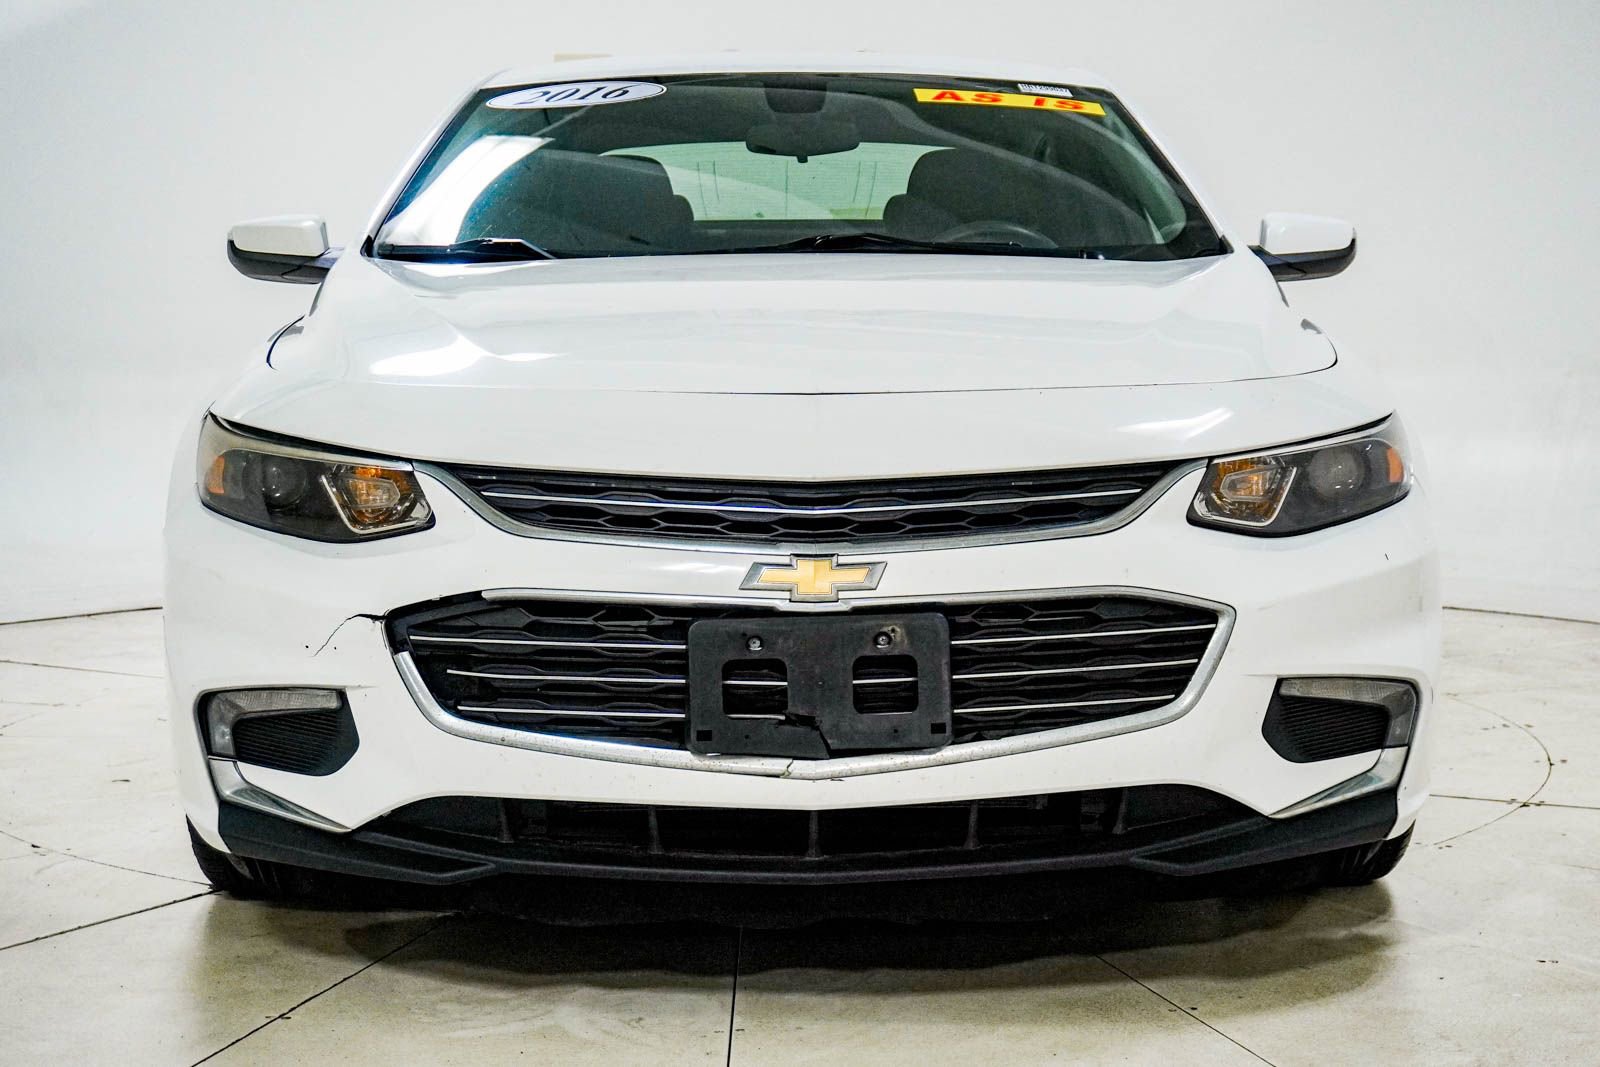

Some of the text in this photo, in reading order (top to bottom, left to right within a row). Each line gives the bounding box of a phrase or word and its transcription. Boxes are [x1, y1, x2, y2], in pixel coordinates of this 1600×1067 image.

[515, 85, 635, 105] 2016
[932, 90, 1085, 110] AS IS
